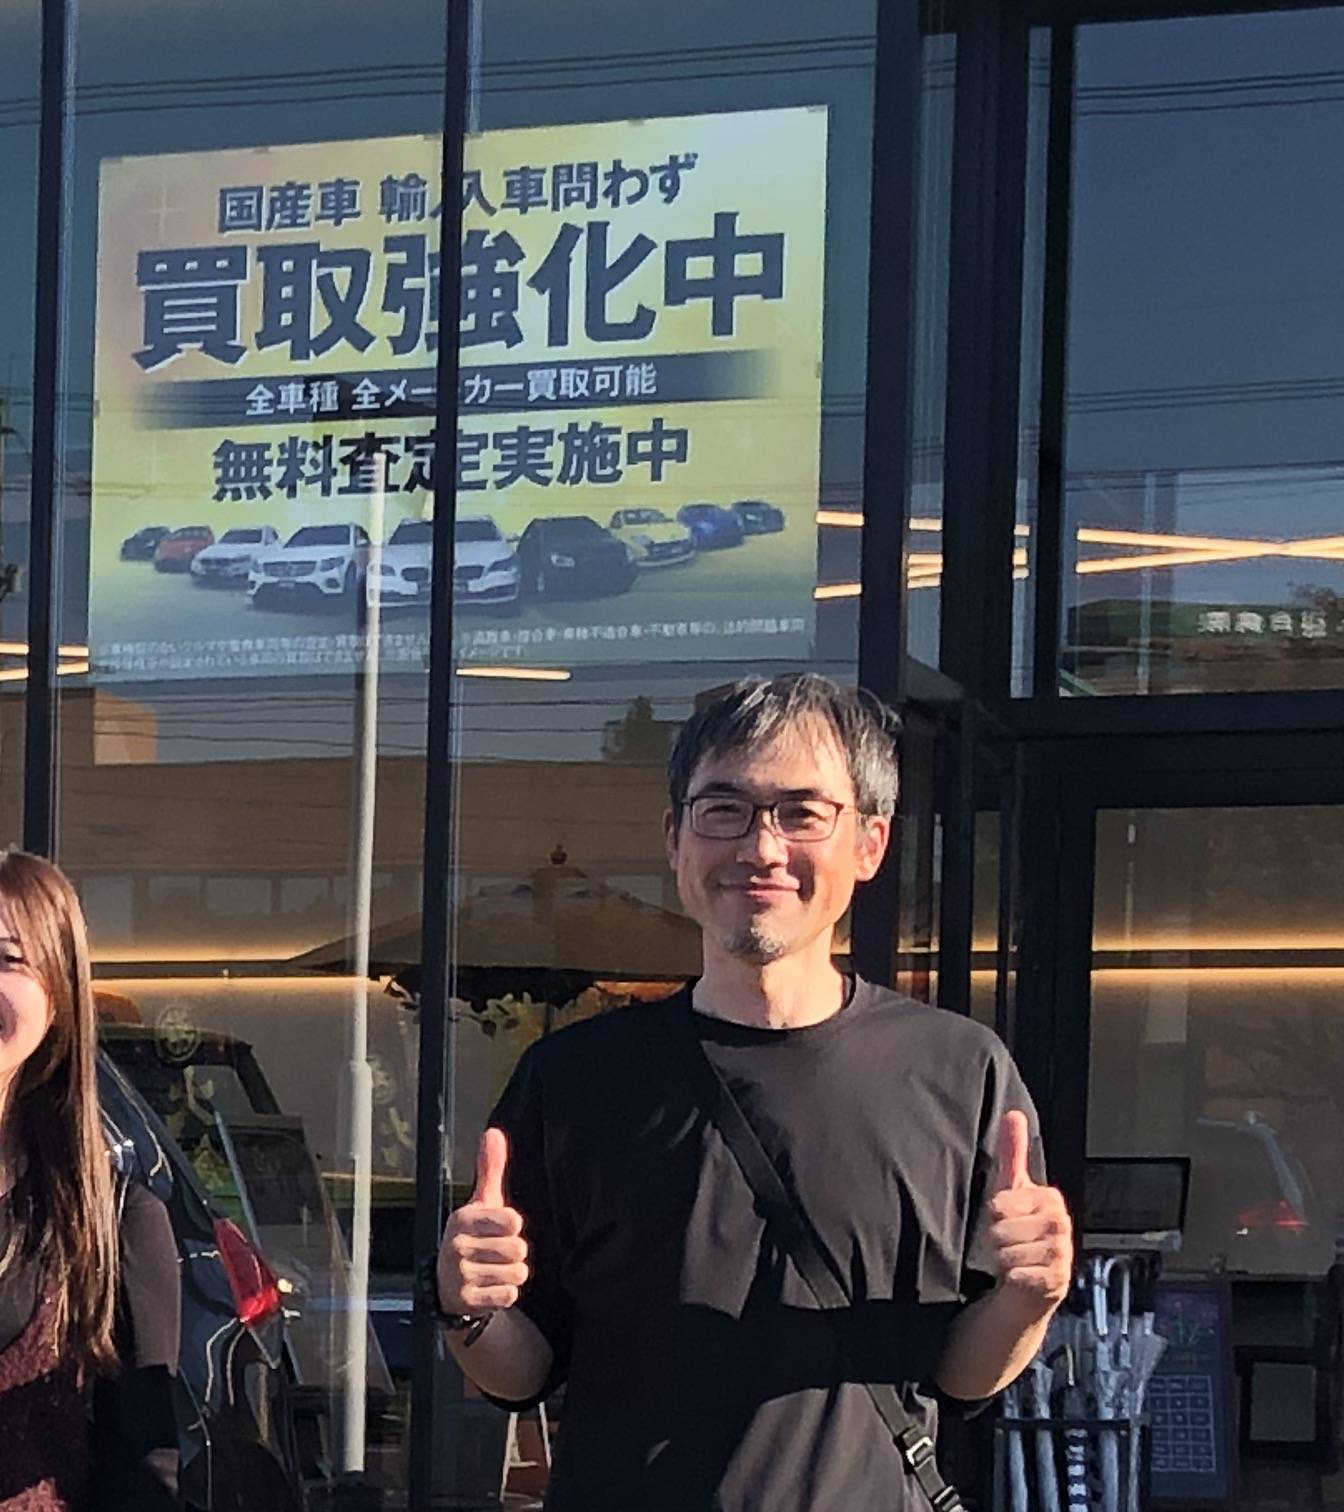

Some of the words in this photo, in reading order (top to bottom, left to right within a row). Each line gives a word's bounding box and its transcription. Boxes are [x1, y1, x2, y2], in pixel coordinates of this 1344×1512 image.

[217, 176, 362, 234] 国産車
[380, 151, 699, 224] 輸入車問わず
[131, 210, 786, 372] 買取強化中
[244, 377, 339, 417] 全車種
[351, 362, 658, 413] 全メーカー買取可能
[210, 417, 690, 502] 無料査定実施中
